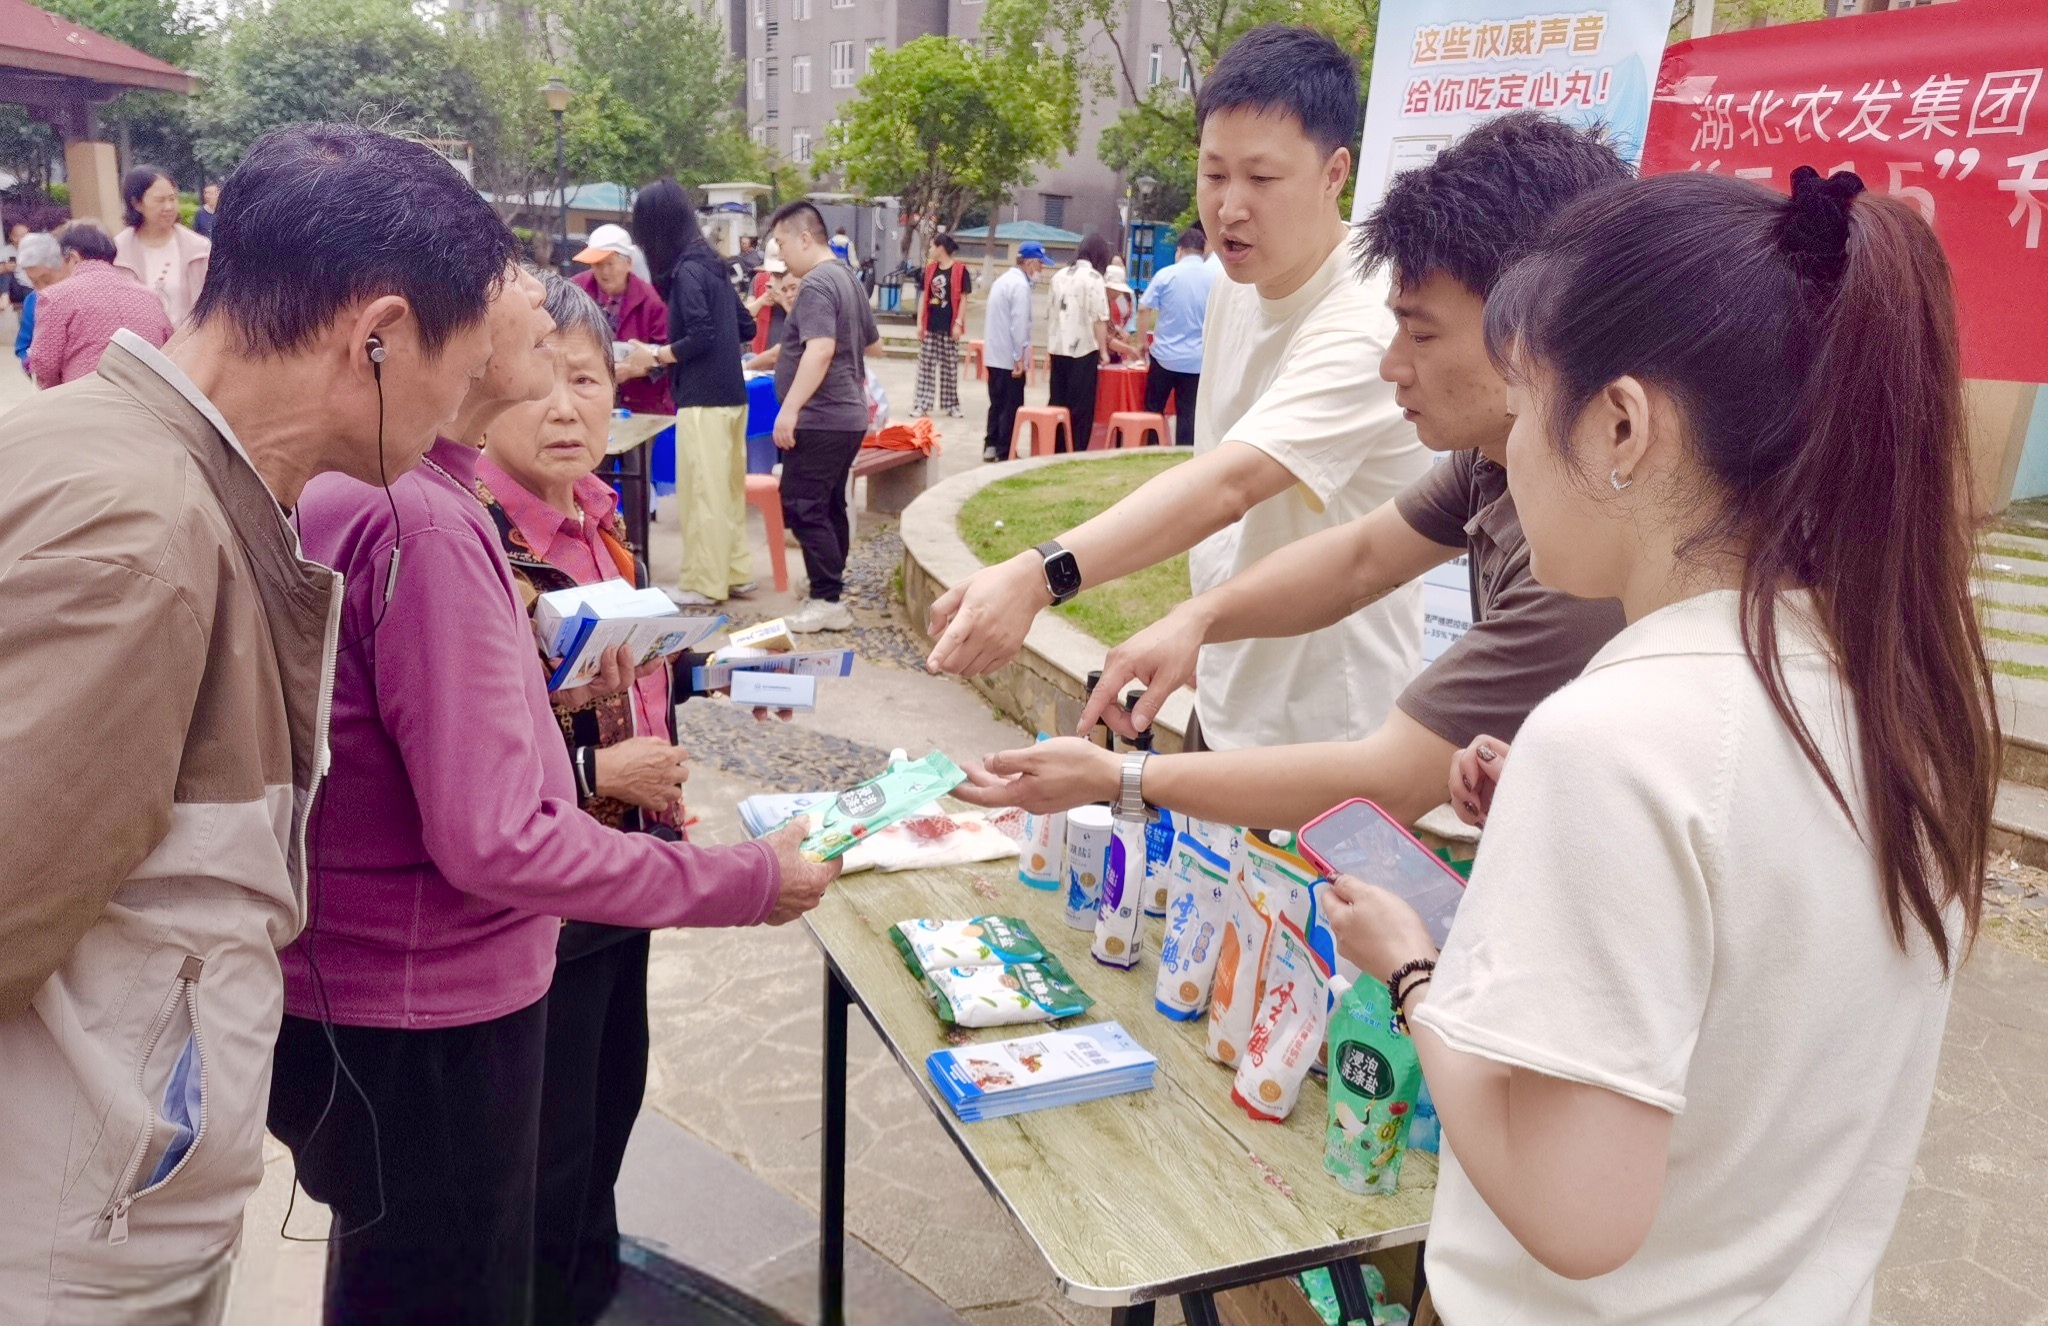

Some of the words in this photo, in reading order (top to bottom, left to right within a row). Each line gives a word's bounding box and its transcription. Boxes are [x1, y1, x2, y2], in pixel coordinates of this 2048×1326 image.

[1413, 15, 1605, 64] 这些权威声音
[1689, 67, 2045, 152] 湖北农发集团
[1342, 1063, 1380, 1095] 洗涤盐
[1349, 1050, 1379, 1076] 浸泡
